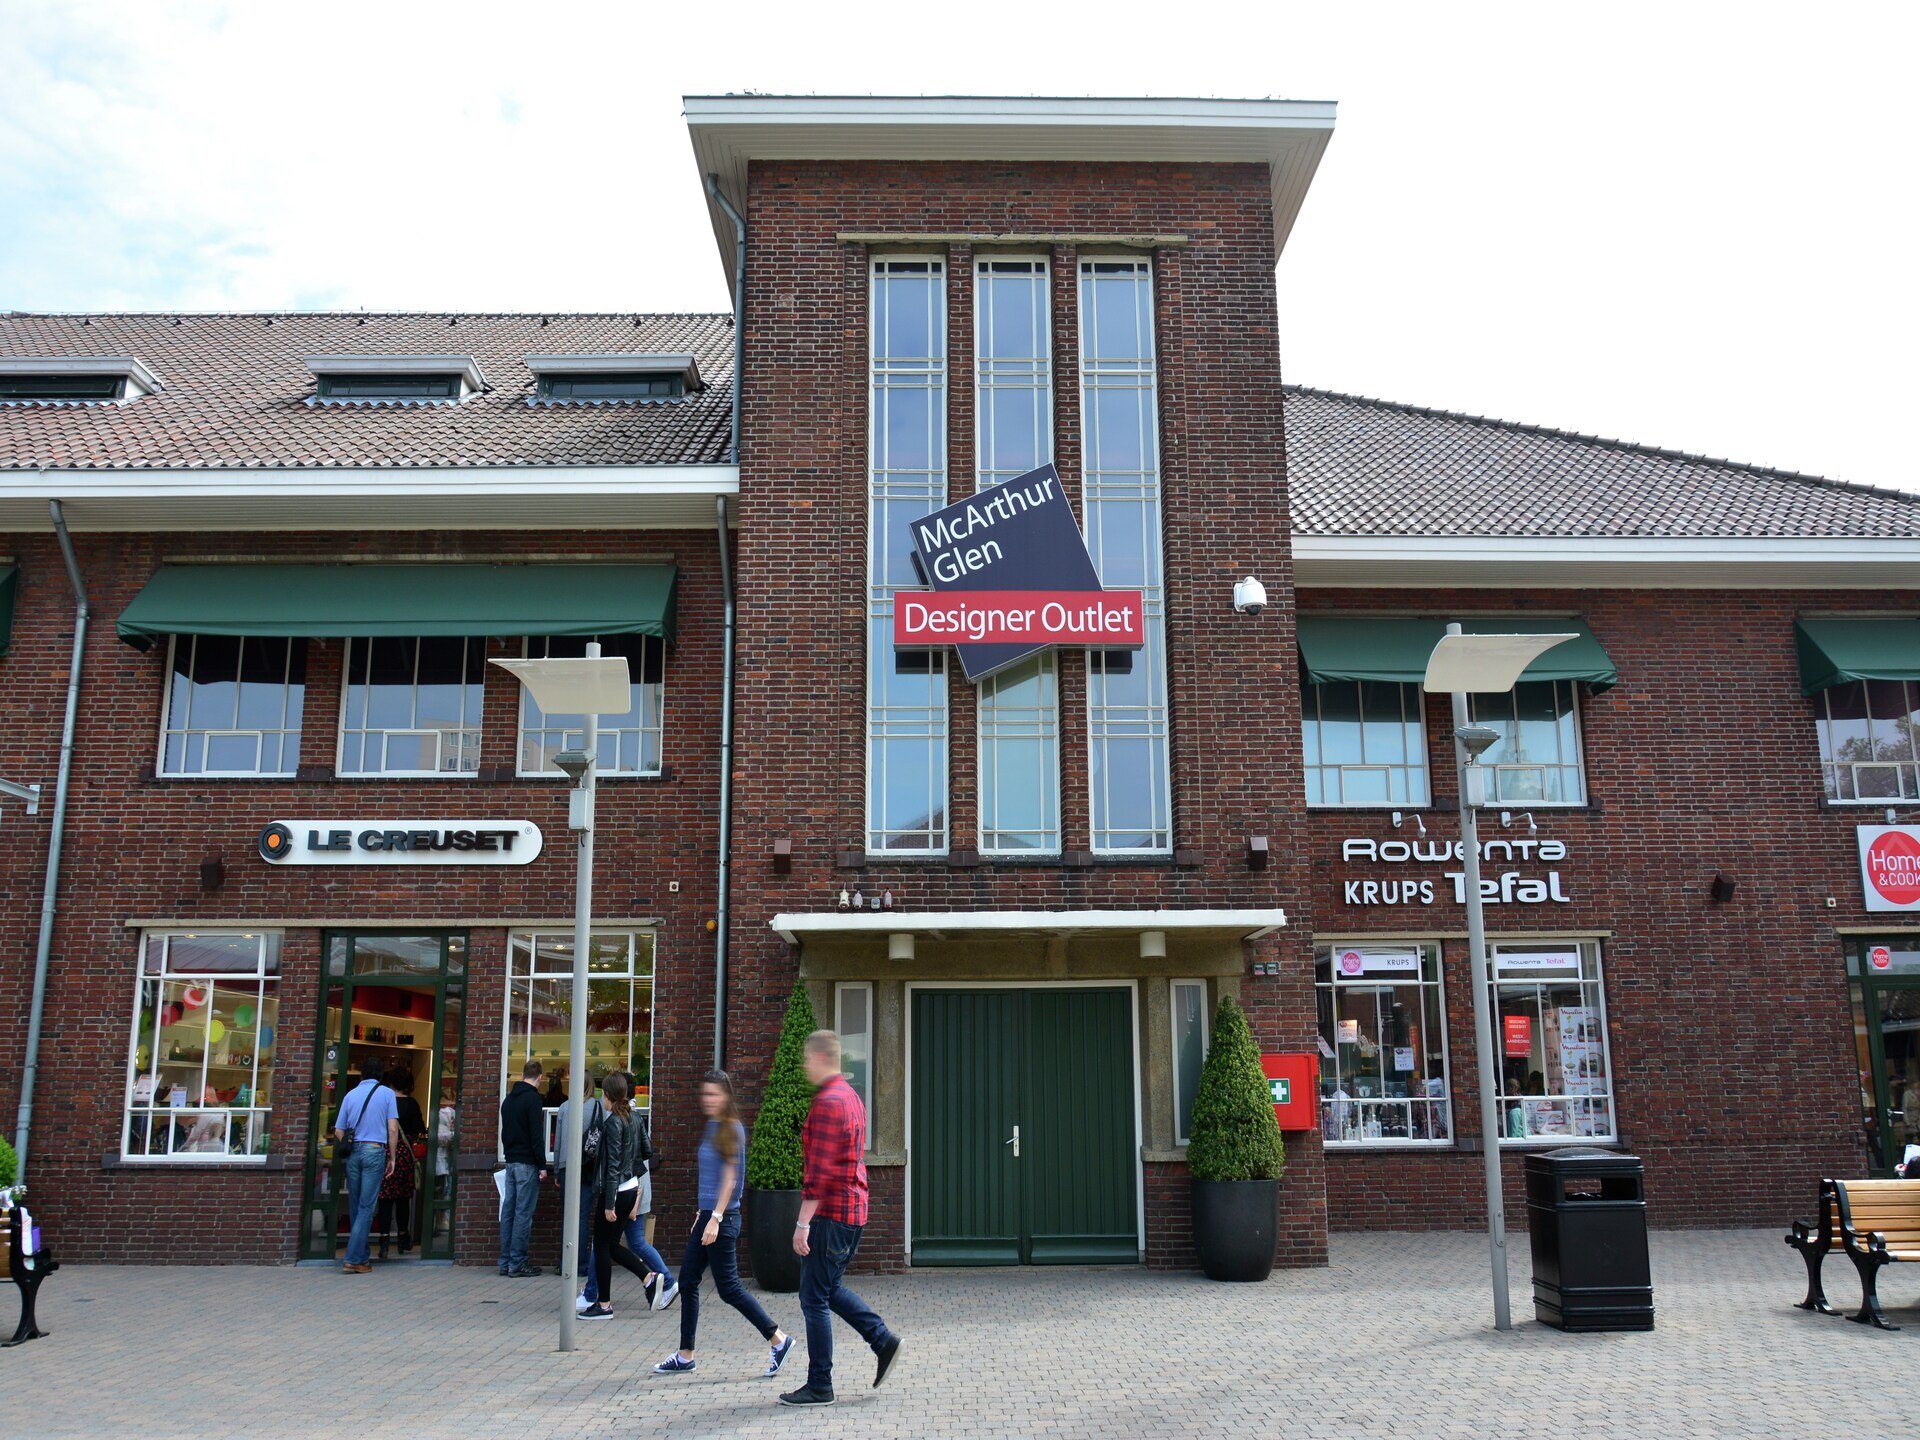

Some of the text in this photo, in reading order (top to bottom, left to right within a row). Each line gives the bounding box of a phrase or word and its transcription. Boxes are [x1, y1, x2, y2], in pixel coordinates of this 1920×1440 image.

[919, 477, 1054, 553] McArthur
[933, 539, 1003, 583] Glen
[905, 602, 1133, 640] Designer Outlet
[307, 830, 519, 851] LE CREUSET
[1344, 871, 1570, 904] KRUPS Tefal
